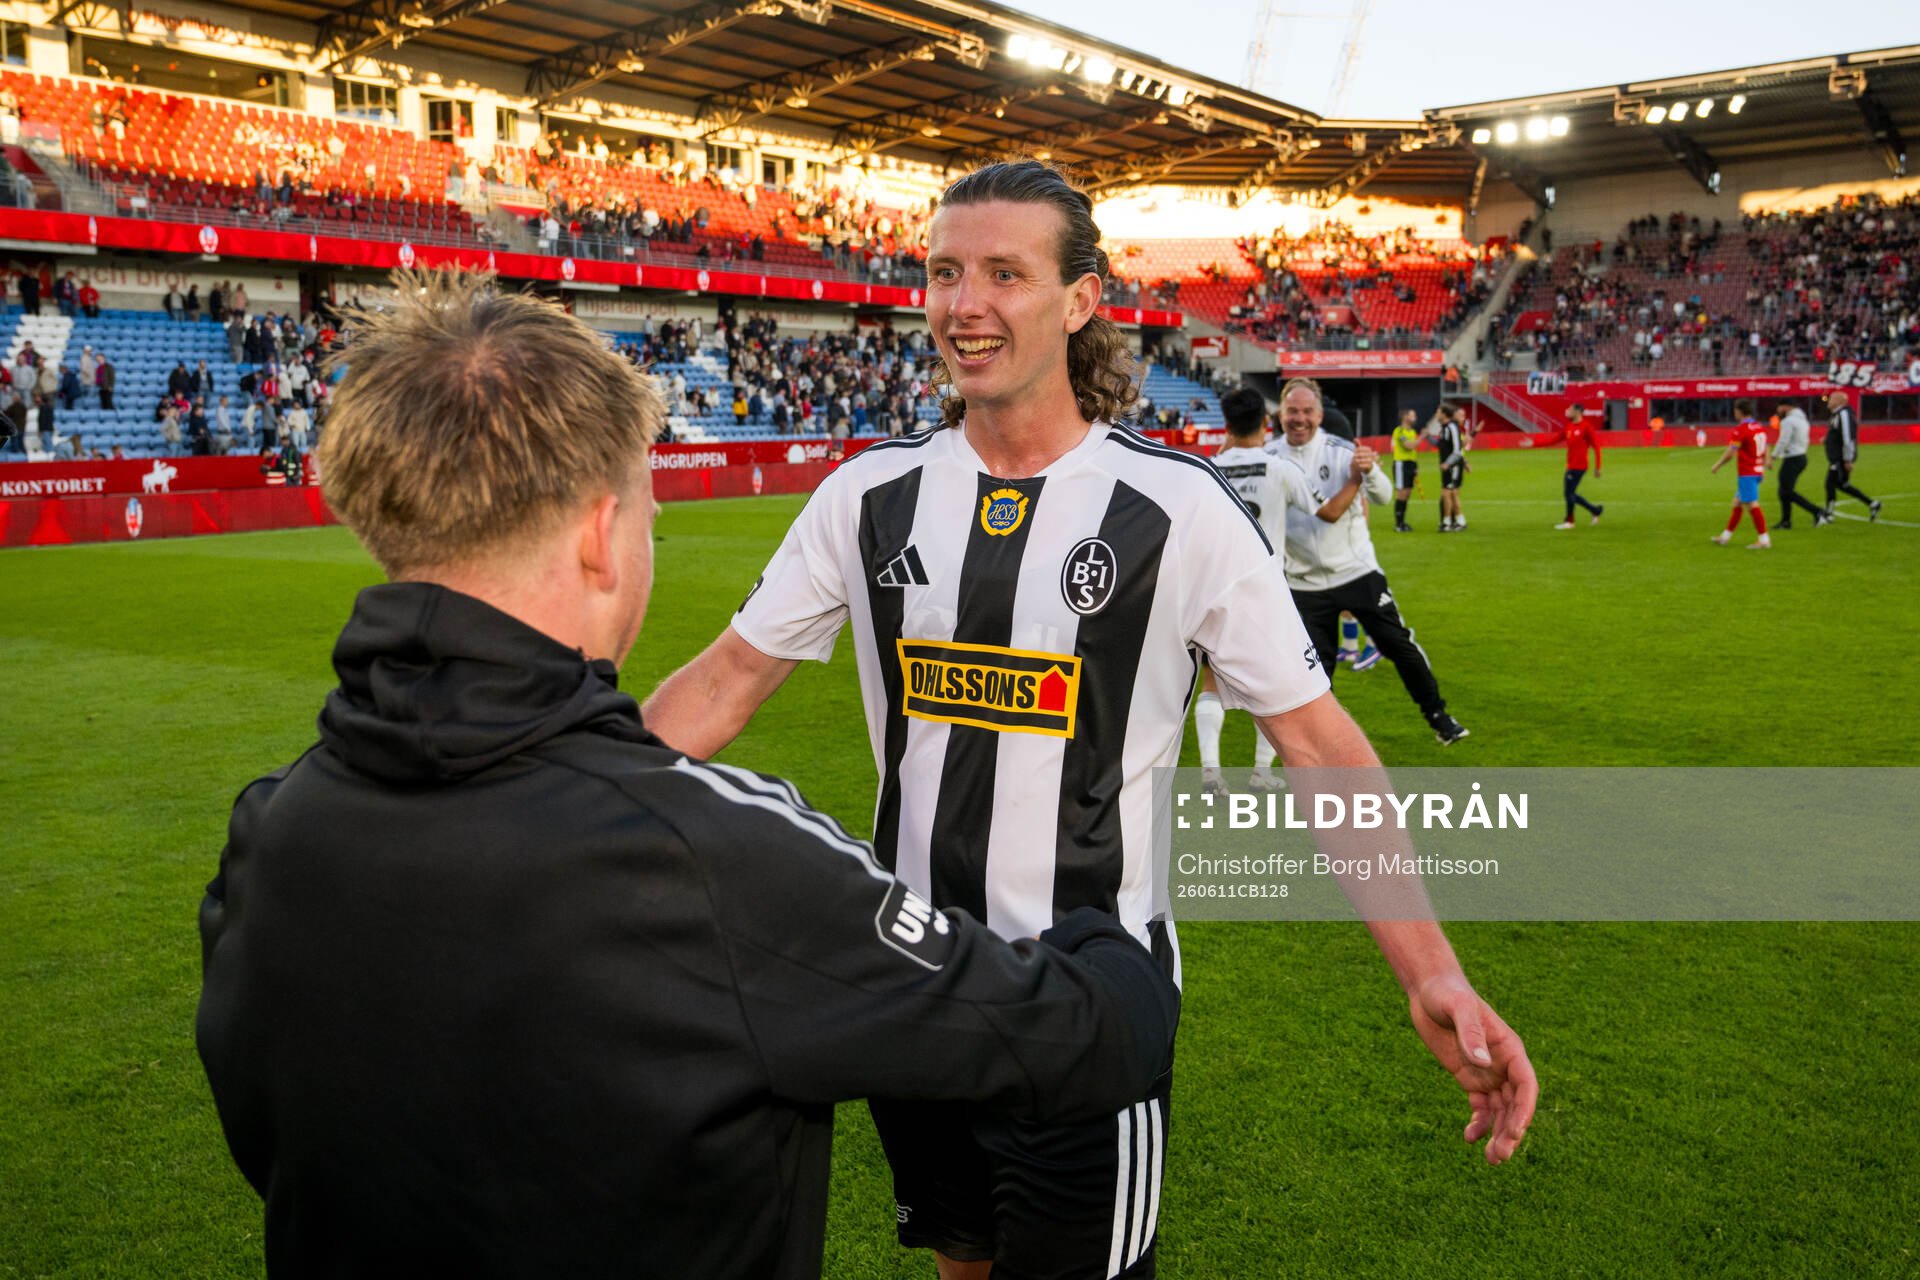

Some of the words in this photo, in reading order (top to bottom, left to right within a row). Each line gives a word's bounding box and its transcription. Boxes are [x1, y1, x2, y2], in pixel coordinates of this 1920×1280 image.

[648, 450, 728, 470] ÉNGRUPPEN
[0, 477, 106, 496] KONTORET
[910, 661, 1037, 709] OHLSSONS
